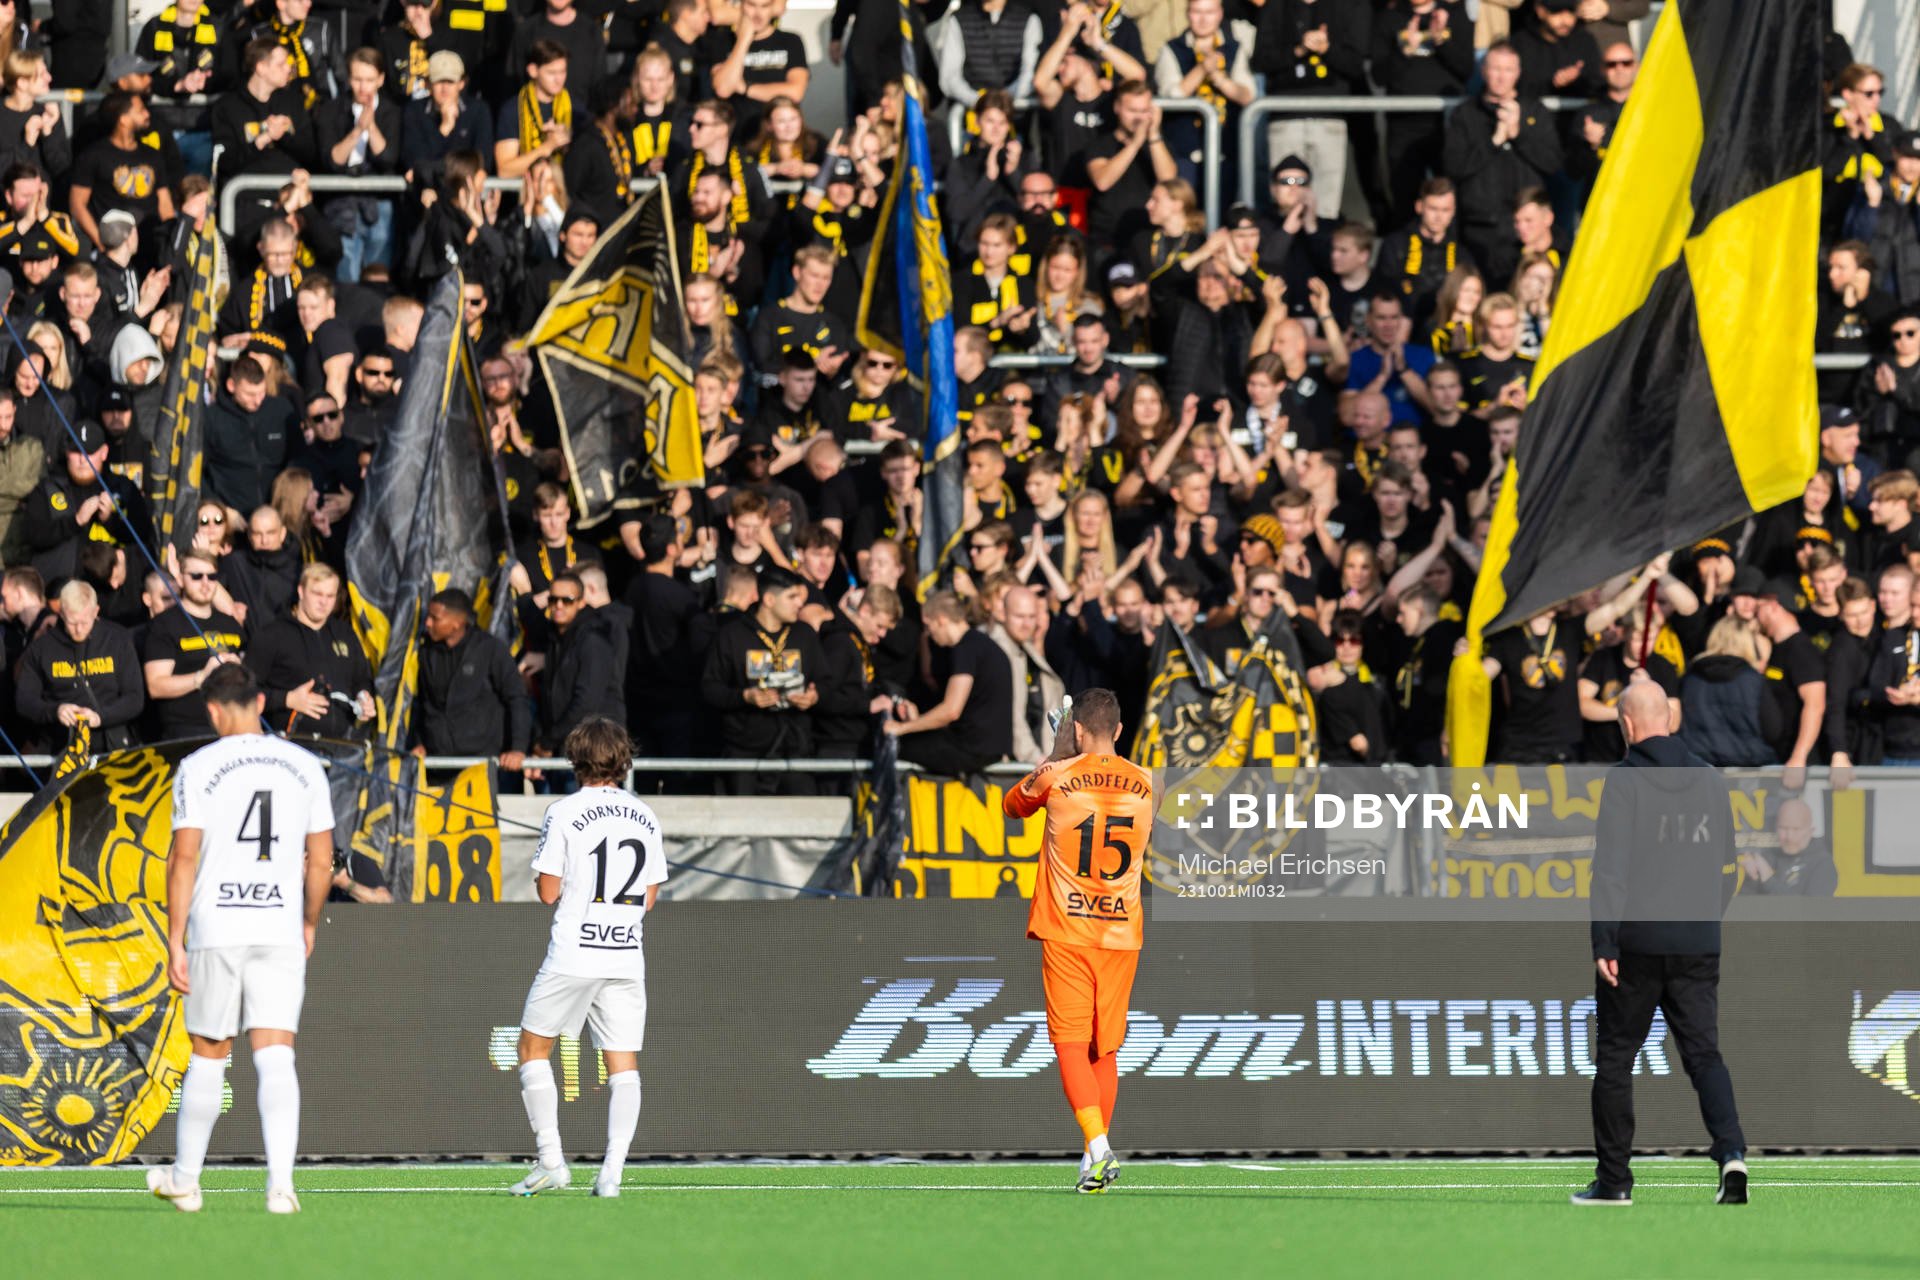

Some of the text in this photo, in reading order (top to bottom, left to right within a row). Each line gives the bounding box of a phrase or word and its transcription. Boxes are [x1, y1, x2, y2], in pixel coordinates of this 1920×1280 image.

[1059, 773, 1151, 800] NORDFELDT
[236, 790, 279, 862] 4
[1073, 812, 1134, 880] 15
[589, 836, 646, 906] 12
[218, 883, 283, 900] SVEA
[1067, 893, 1128, 914] SVEA
[580, 923, 638, 943] SVEA
